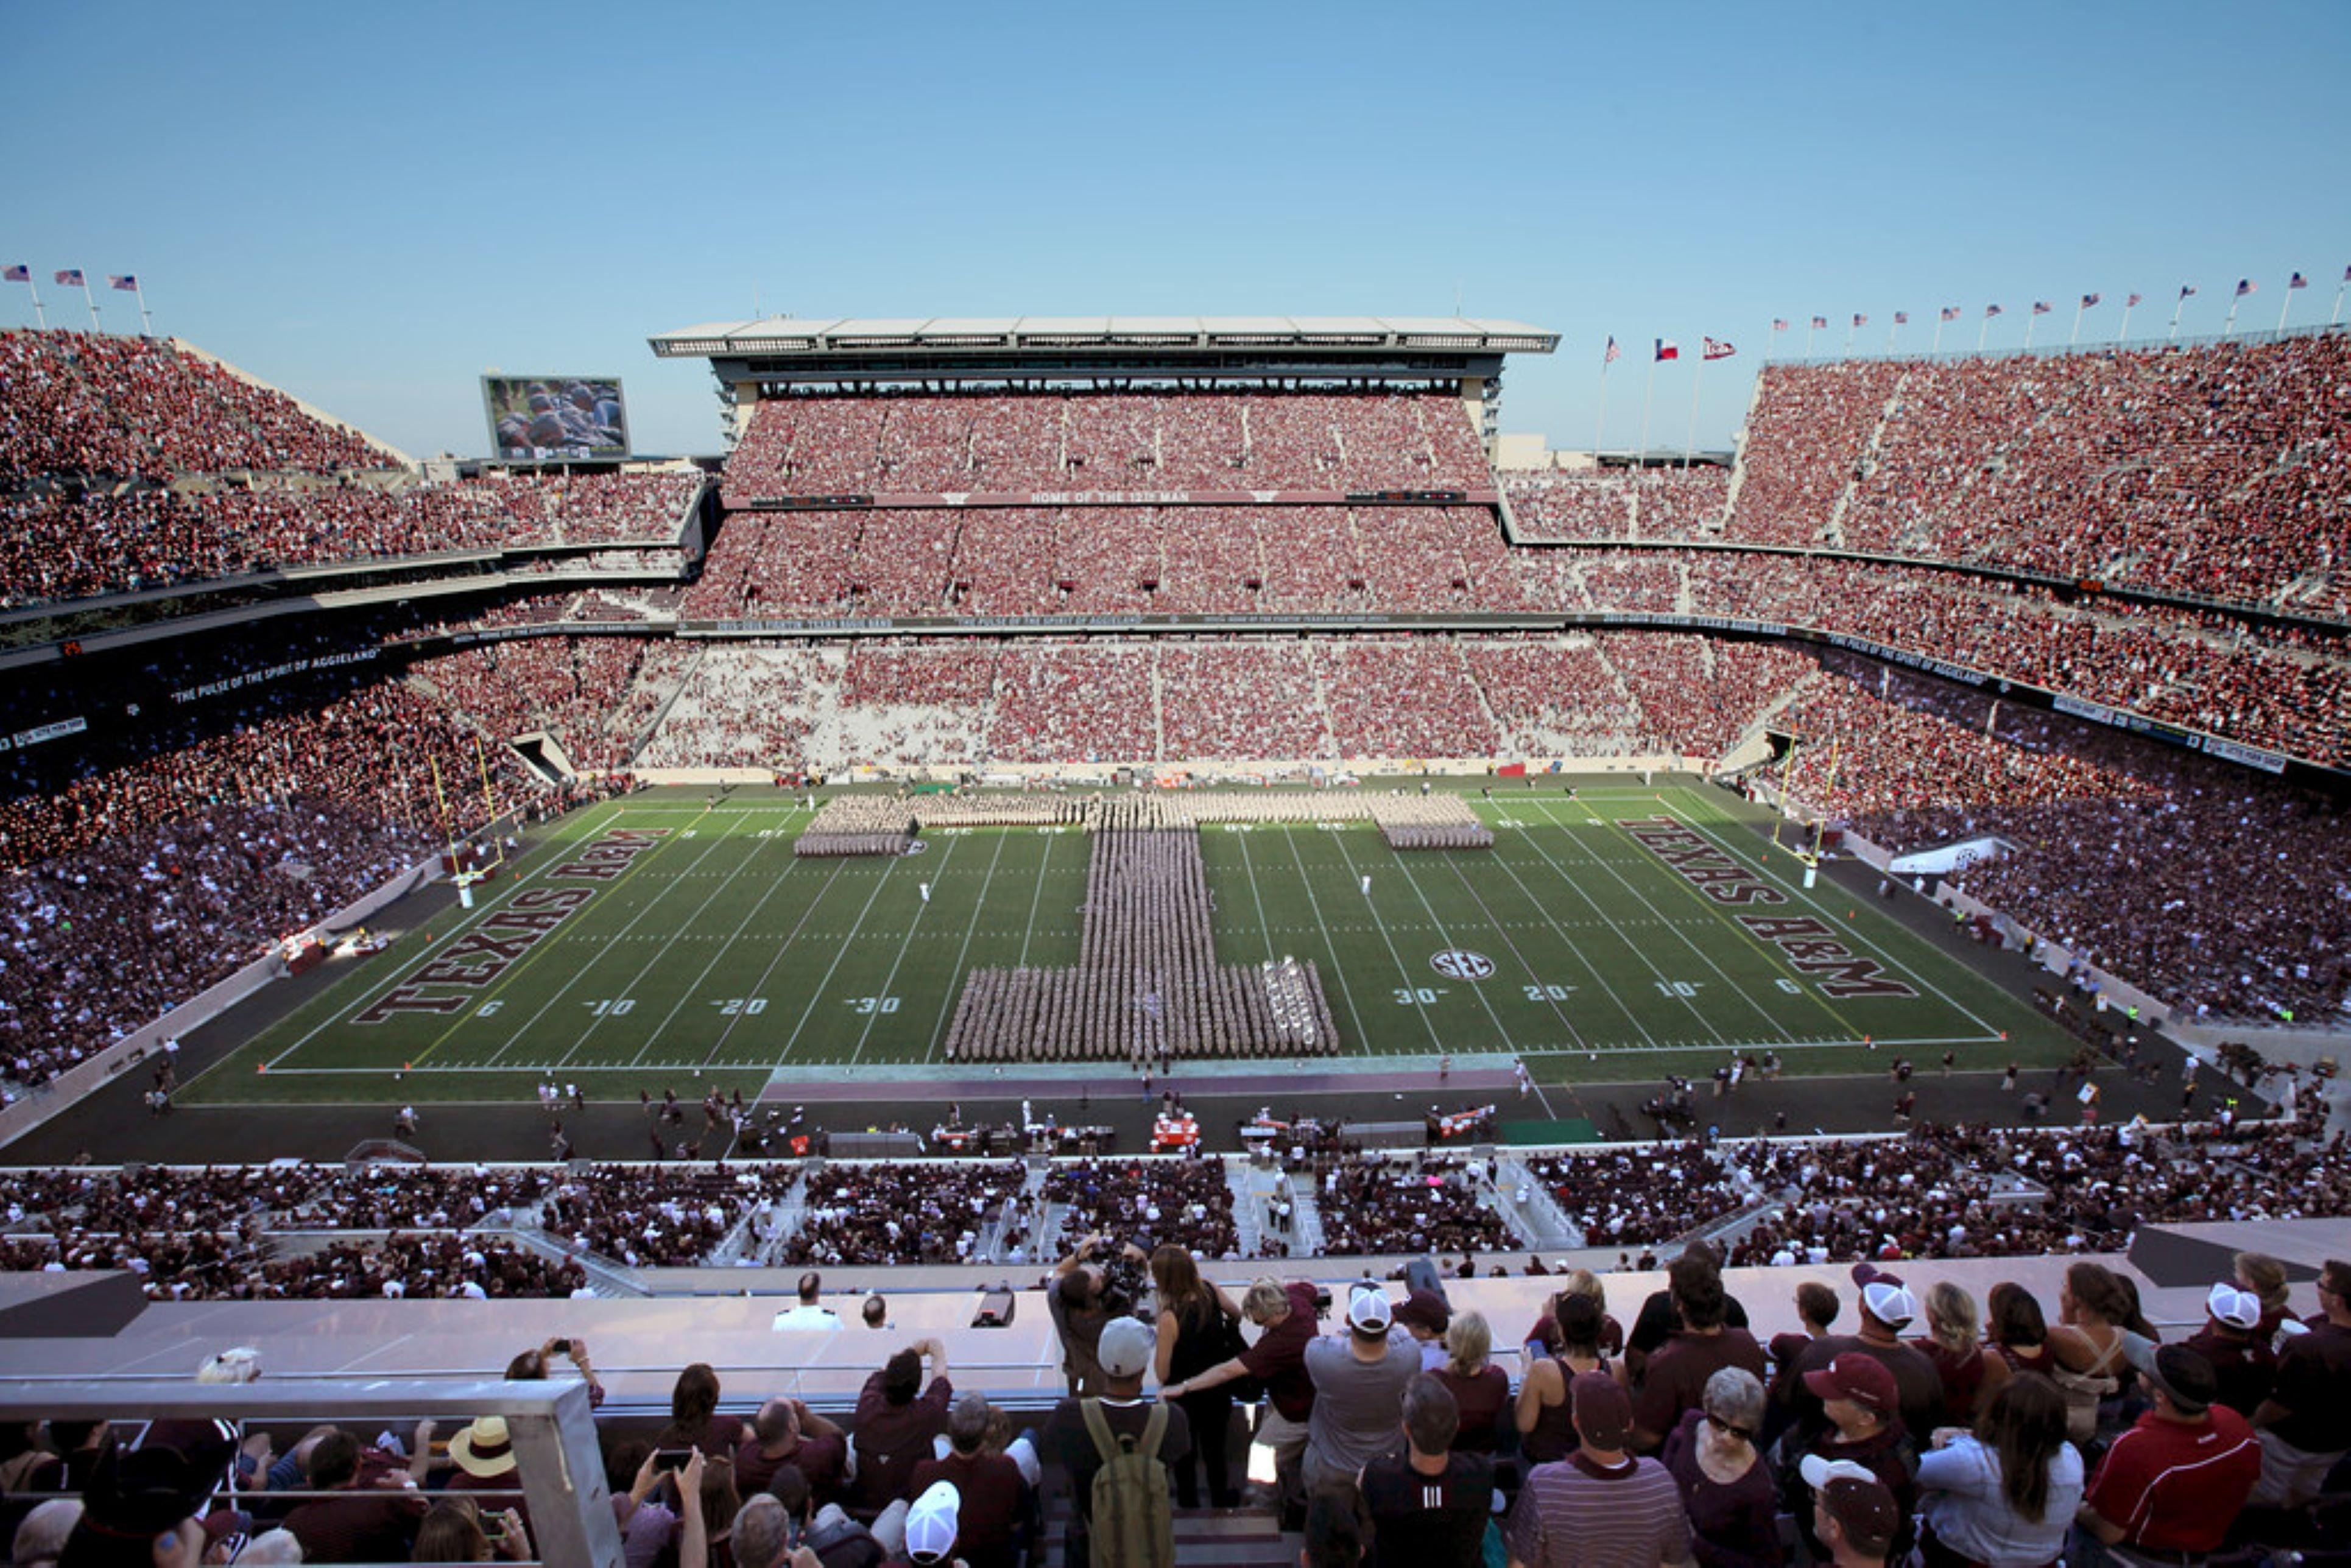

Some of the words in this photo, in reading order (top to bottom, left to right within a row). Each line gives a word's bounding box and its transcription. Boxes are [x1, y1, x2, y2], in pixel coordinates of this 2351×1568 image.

[1031, 492, 1069, 503] HOME
[1075, 491, 1090, 503] OF
[1098, 491, 1124, 503] THE
[1160, 491, 1189, 502] MAN
[198, 678, 230, 698] PULSE
[230, 675, 243, 689] OF
[245, 670, 264, 684] THE
[265, 662, 292, 680] SPIRIT
[294, 659, 309, 672] OF
[1614, 814, 1789, 906] TEXAS
[1734, 914, 1921, 999] A&M
[350, 886, 597, 1024] TEXAS
[546, 827, 674, 882] A&M
[1431, 949, 1494, 979] SEC
[1392, 988, 1437, 1004] 30
[1523, 985, 1568, 1001] 20
[1654, 980, 1697, 997] 10
[591, 999, 636, 1017] 10
[719, 999, 769, 1015] 20
[855, 997, 901, 1013] 30
